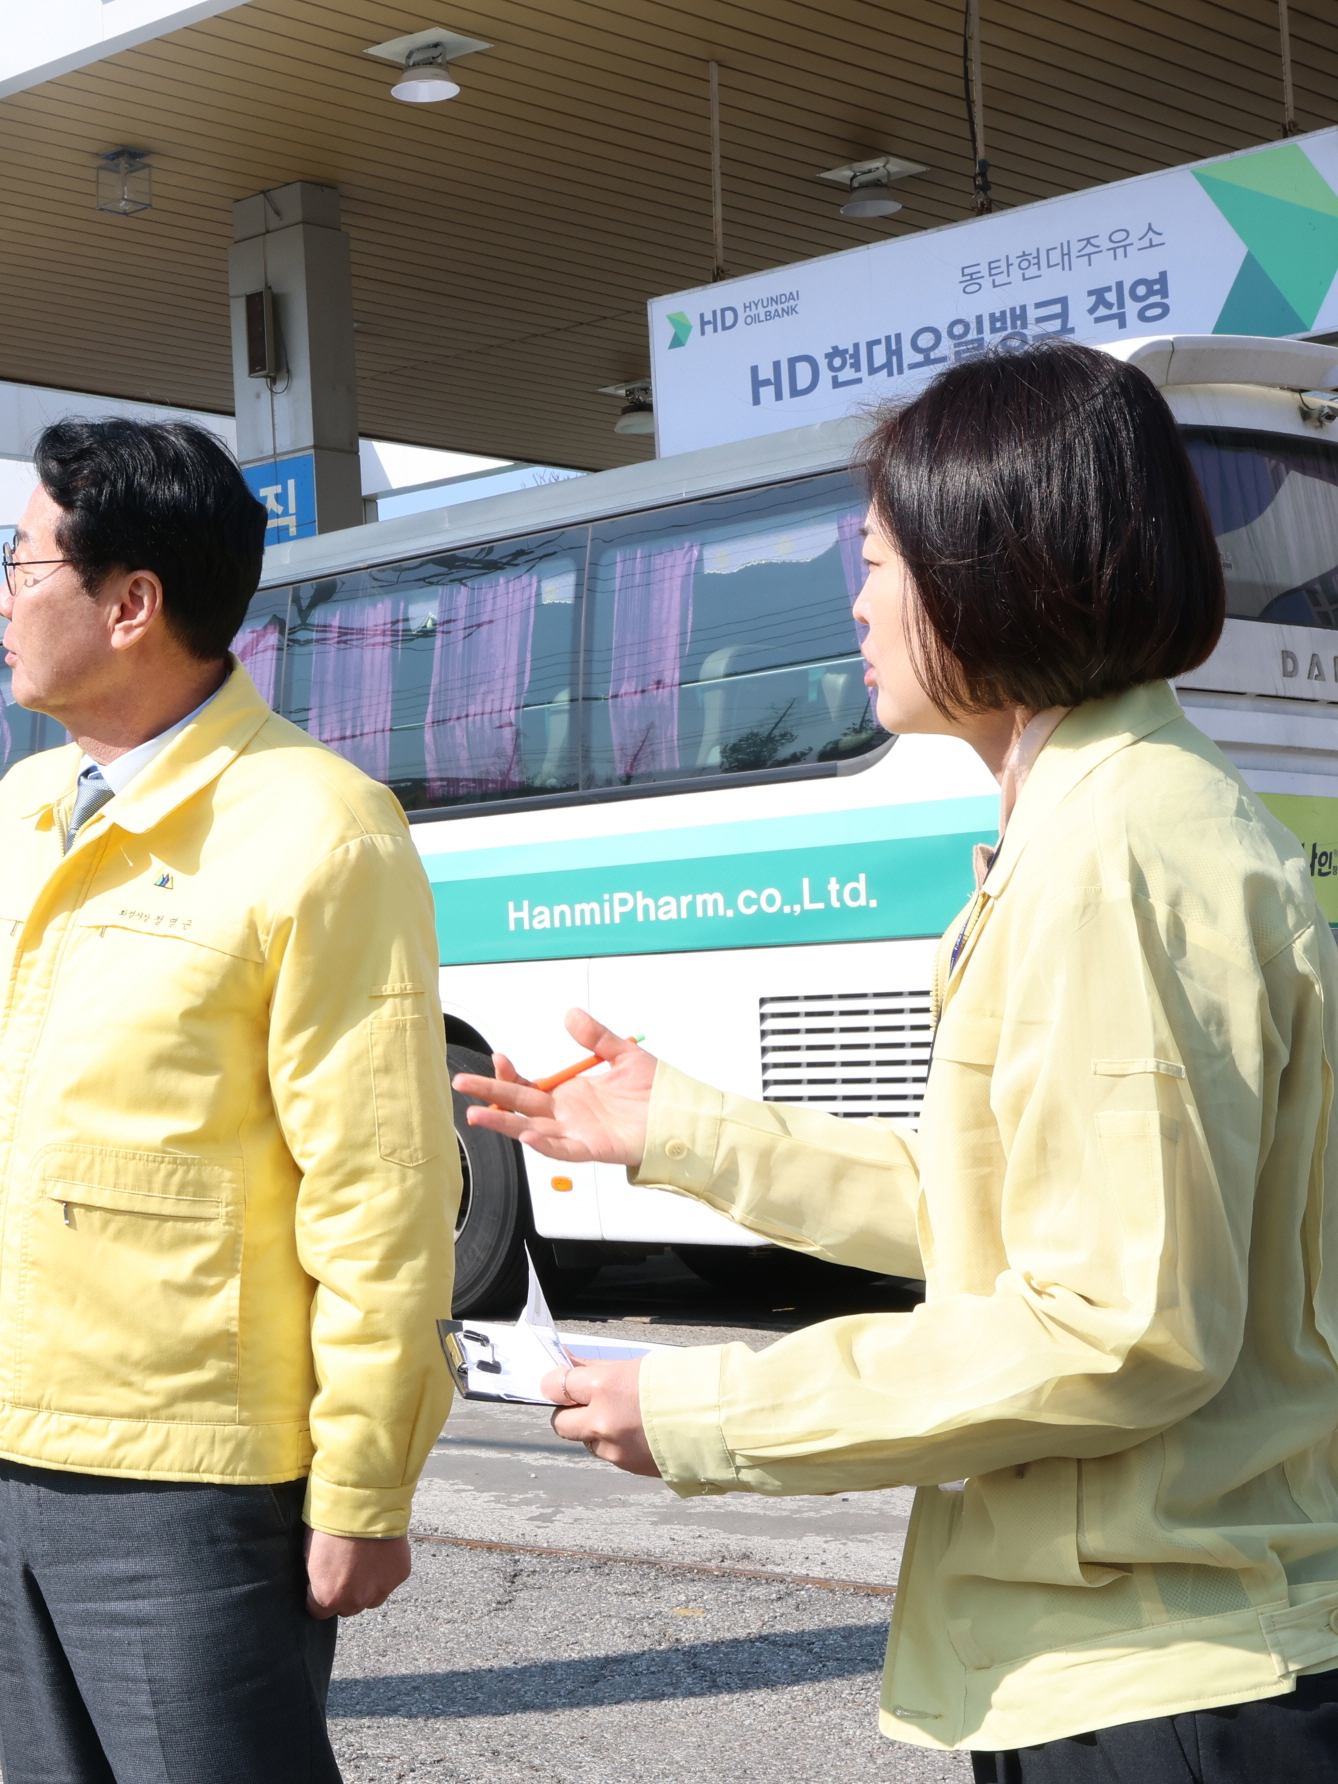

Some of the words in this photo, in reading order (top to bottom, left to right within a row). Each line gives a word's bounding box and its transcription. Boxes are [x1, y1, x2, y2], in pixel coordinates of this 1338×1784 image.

[959, 222, 1166, 295] 동탄현대주유소
[699, 305, 739, 336] HD
[743, 290, 800, 313] HYUNDAI
[744, 304, 799, 326] OILBANK
[1086, 270, 1171, 330] 직영
